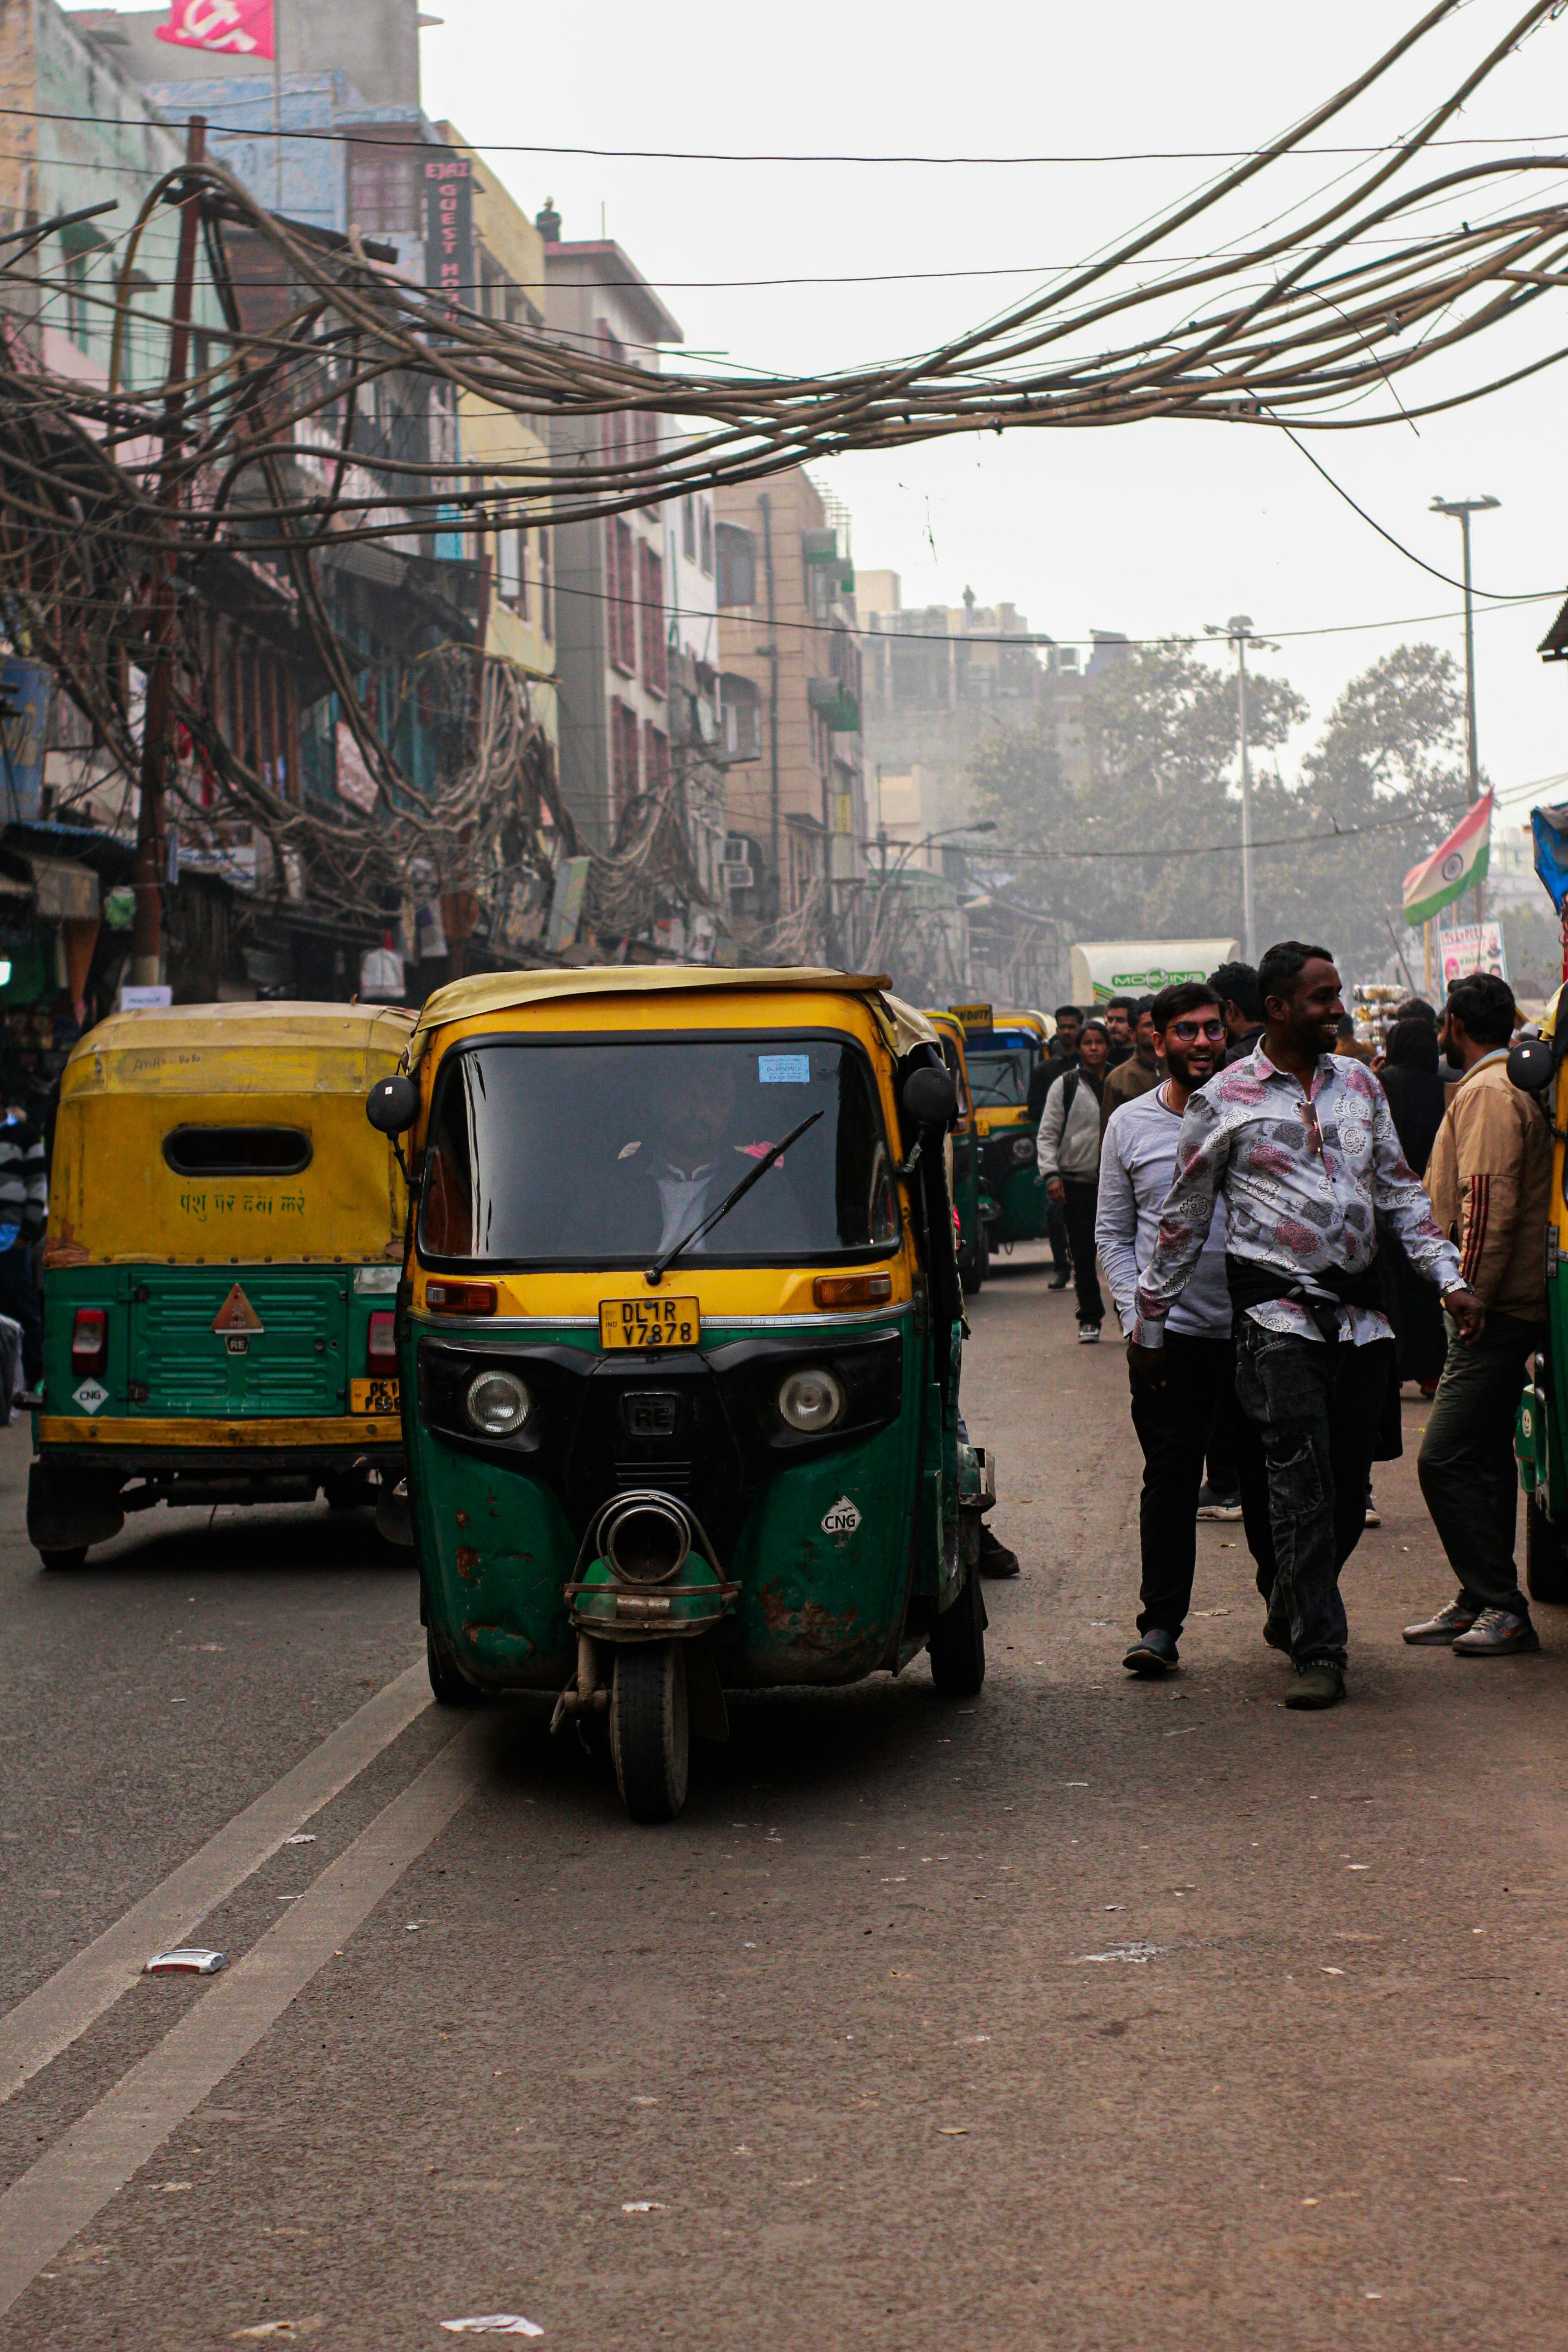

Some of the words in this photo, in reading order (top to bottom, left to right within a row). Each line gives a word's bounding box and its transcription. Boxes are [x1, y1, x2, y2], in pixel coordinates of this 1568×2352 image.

[425, 162, 470, 180] EJAZ
[439, 183, 457, 254] GUEST
[622, 1300, 676, 1323] DL1R
[622, 1321, 691, 1344] V7878
[230, 1340, 245, 1350] RE
[79, 1391, 101, 1401] CNG
[635, 1407, 670, 1427] RE
[825, 1514, 856, 1529] CNG
